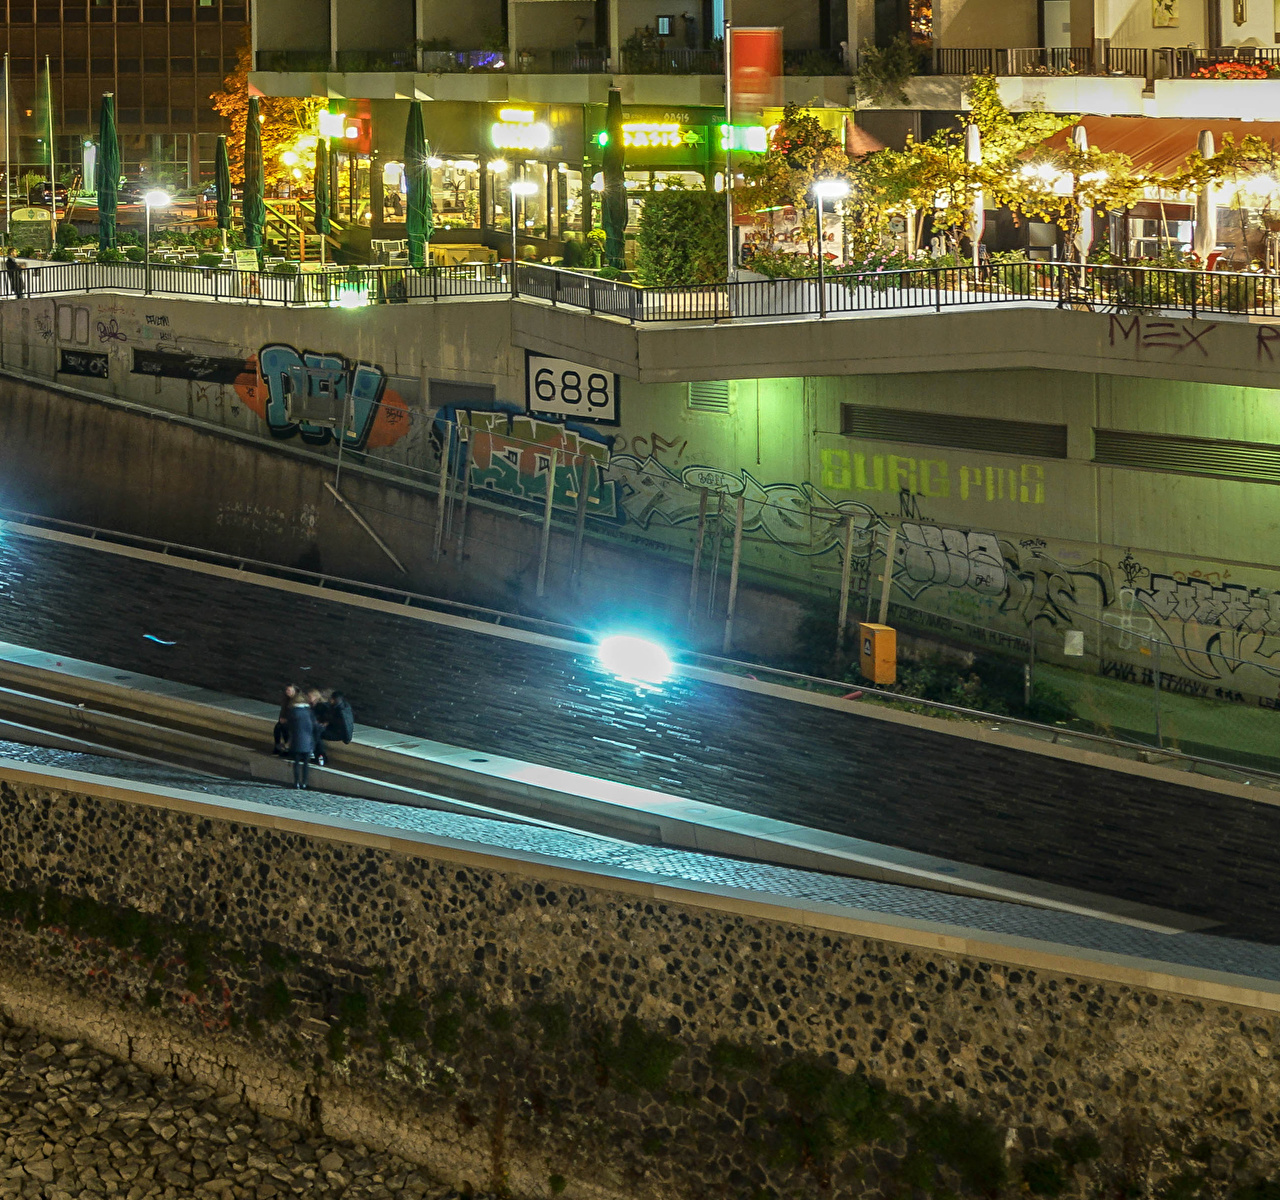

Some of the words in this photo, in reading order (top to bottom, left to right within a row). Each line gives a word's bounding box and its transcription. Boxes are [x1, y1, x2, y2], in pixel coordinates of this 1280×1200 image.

[663, 112, 690, 123] OASIS
[1109, 314, 1219, 358] MEX
[535, 368, 609, 407] 688
[821, 449, 950, 498] BURG
